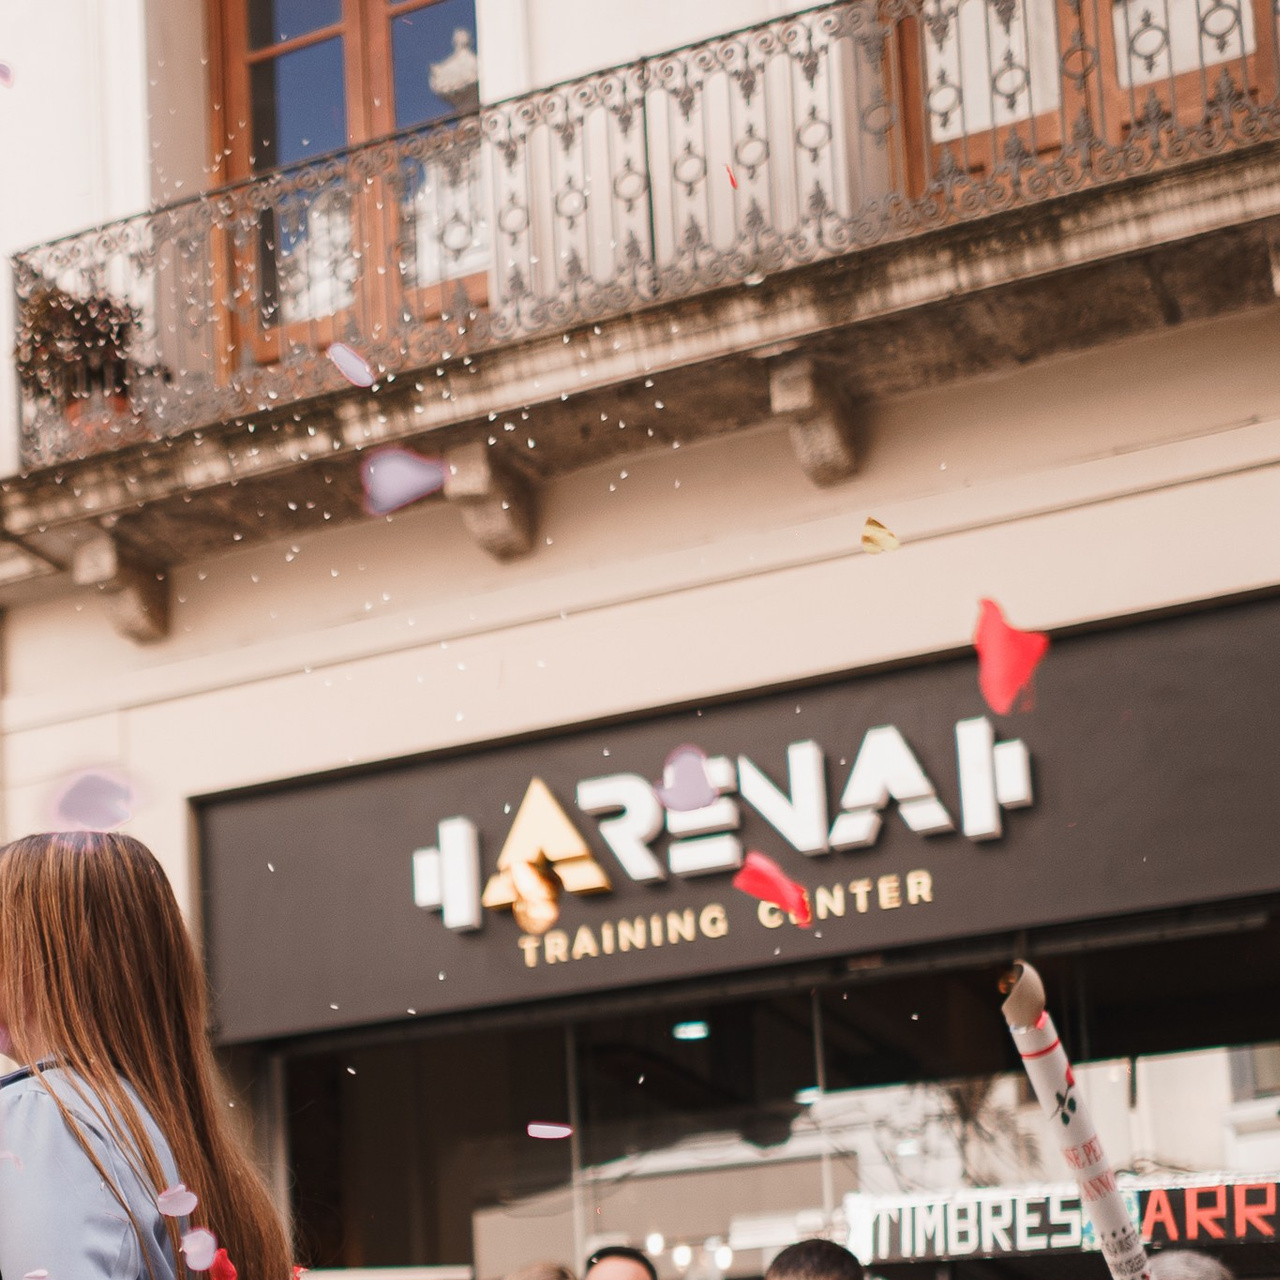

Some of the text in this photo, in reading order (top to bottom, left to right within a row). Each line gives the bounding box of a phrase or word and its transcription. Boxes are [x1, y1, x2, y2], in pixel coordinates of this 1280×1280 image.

[482, 725, 954, 908] ARENA
[518, 869, 934, 968] TRAINING CNTER
[870, 1193, 1082, 1260] TIMBRES
[1141, 1182, 1278, 1243] ARR
